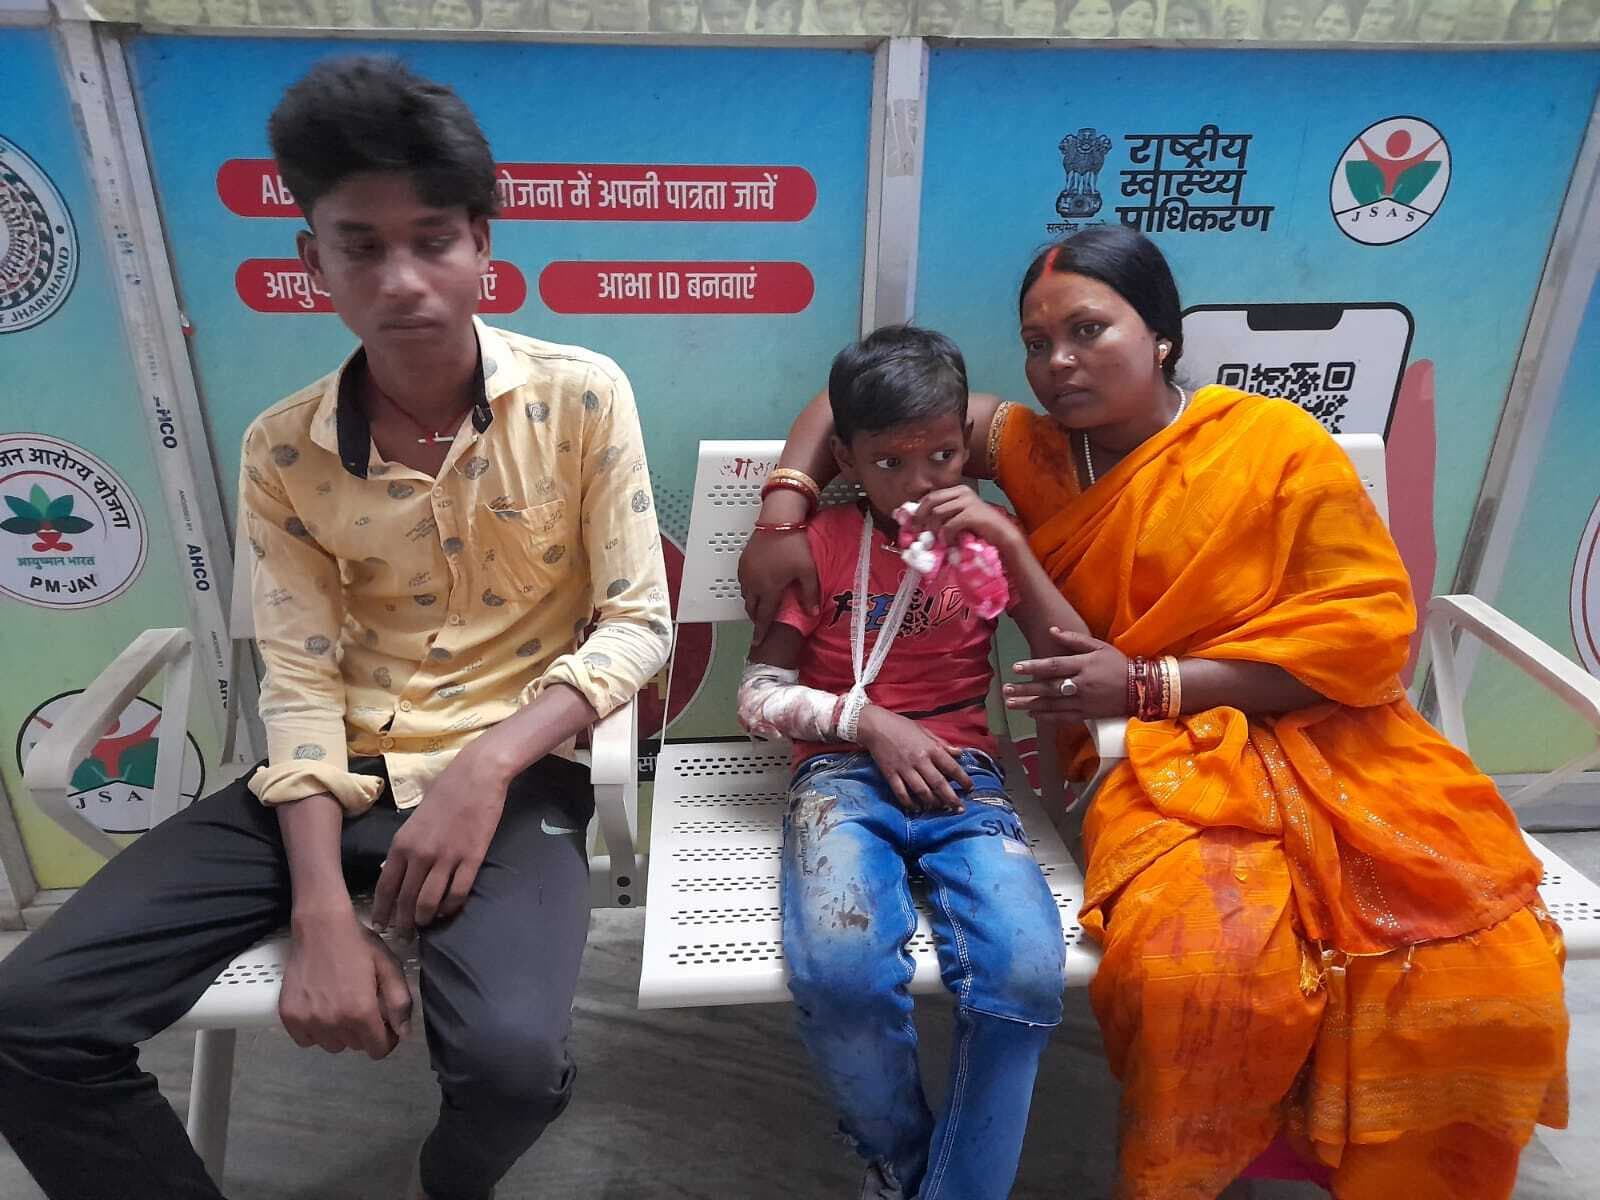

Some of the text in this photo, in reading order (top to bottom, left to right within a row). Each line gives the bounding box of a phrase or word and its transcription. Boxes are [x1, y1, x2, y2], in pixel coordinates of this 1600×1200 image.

[1124, 124, 1252, 169] राष्ट्रीय
[262, 174, 295, 205] AB
[568, 170, 593, 208] में
[598, 171, 660, 209] अपनी
[664, 180, 727, 210] पात्रता
[731, 173, 778, 210] जाचें
[1120, 169, 1248, 205] स्वास्थ्य
[1352, 207, 1415, 222] JSAS
[11, 246, 70, 322] JHARKHAND
[598, 266, 758, 300] आभा ID बनवाएं
[29, 447, 94, 481] आरोग्य
[94, 475, 131, 529] योजना
[30, 573, 98, 593] PM-JAY
[187, 543, 210, 591] AHCO
[75, 790, 143, 810] JSA
